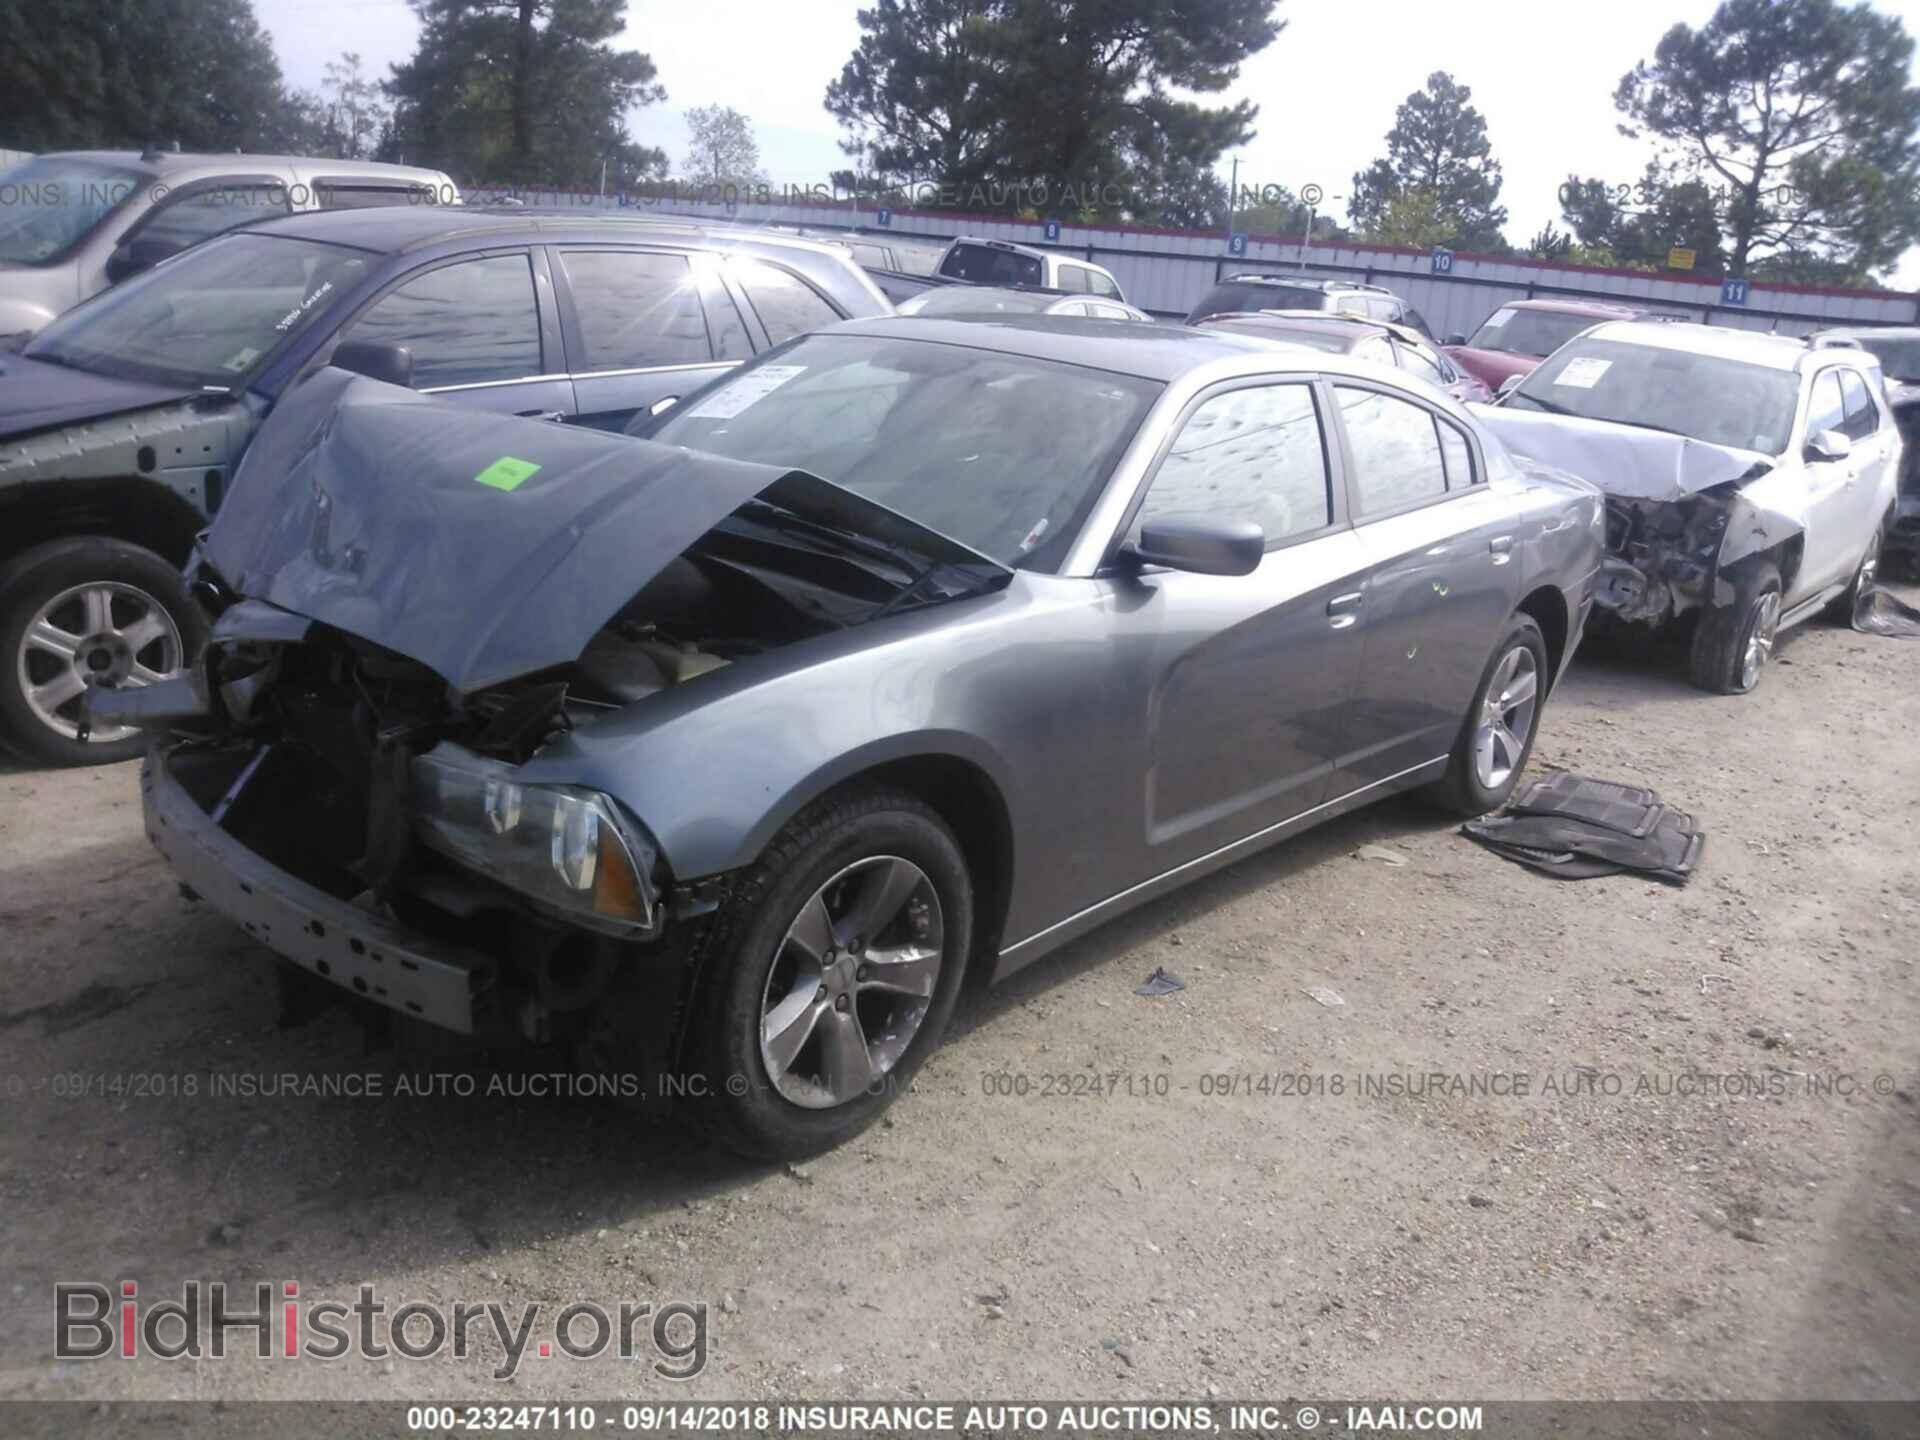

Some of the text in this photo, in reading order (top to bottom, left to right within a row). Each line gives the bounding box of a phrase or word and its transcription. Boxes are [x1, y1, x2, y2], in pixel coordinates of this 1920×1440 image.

[1234, 237, 1242, 251] 9
[1434, 255, 1450, 270] 10
[1728, 284, 1743, 300] 11
